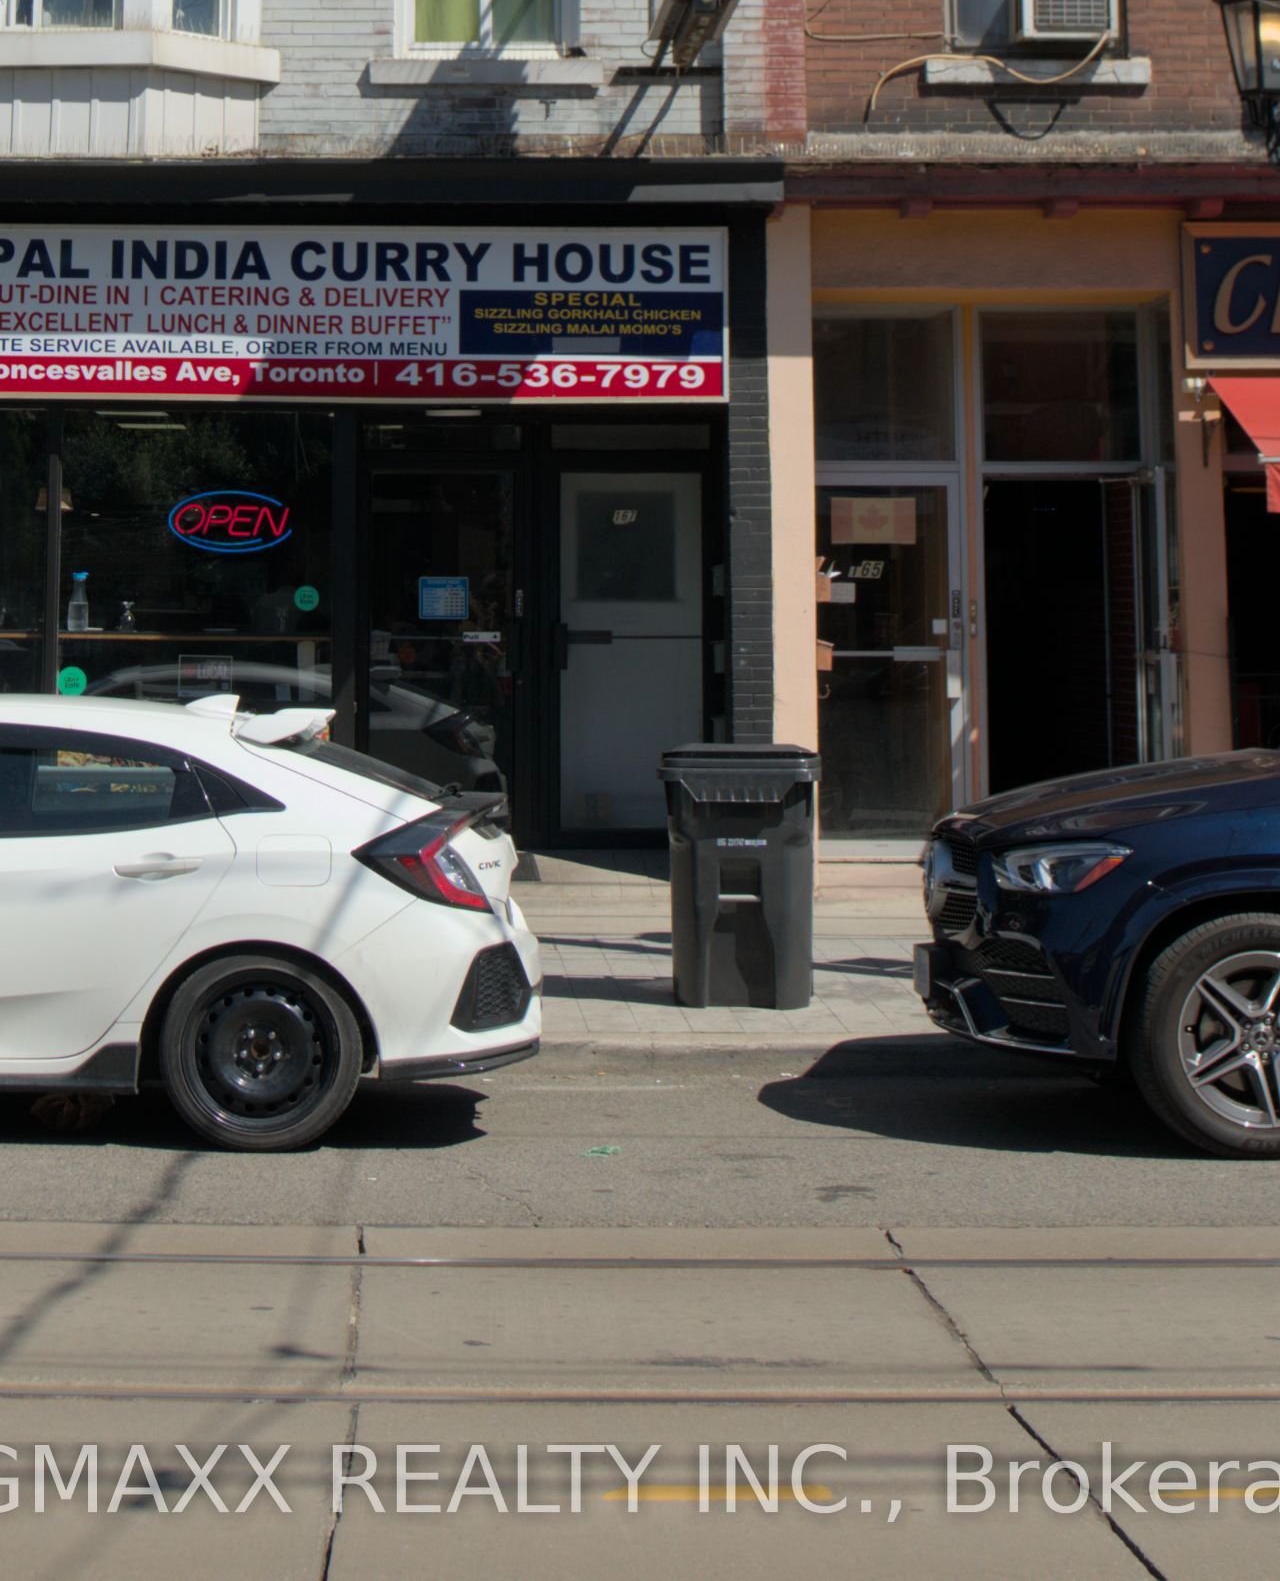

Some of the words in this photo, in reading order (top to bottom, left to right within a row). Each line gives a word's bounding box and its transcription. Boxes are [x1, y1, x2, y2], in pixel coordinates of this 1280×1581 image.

[111, 239, 271, 280] INDIA
[290, 240, 493, 282] CURRY
[512, 242, 711, 284] HOUSE
[107, 285, 130, 305] IN
[160, 285, 290, 307] CATERING
[298, 287, 316, 307] &
[324, 287, 451, 308] DELIVERY
[534, 291, 642, 308] SPECIAL
[147, 313, 226, 334] LUNCH
[233, 314, 249, 335] &
[256, 314, 344, 335] DINNER
[474, 308, 544, 320] SIZZLING
[548, 308, 628, 321] GORKHALI
[632, 309, 702, 322] CHICKEN
[493, 322, 563, 335] SIZZLING
[567, 323, 615, 336] MALAI
[619, 323, 683, 337] MOMO'S
[29, 337, 117, 354] SERVICE
[122, 339, 240, 357] AVAILABLE,
[246, 340, 318, 356] ORDER
[325, 341, 382, 357] FROM
[389, 342, 449, 357] MENU
[176, 361, 241, 386] Ave,
[249, 362, 366, 384] Toronto
[395, 363, 706, 389] 416-536-7979
[174, 503, 290, 537] OPEN
[852, 562, 883, 578] 165
